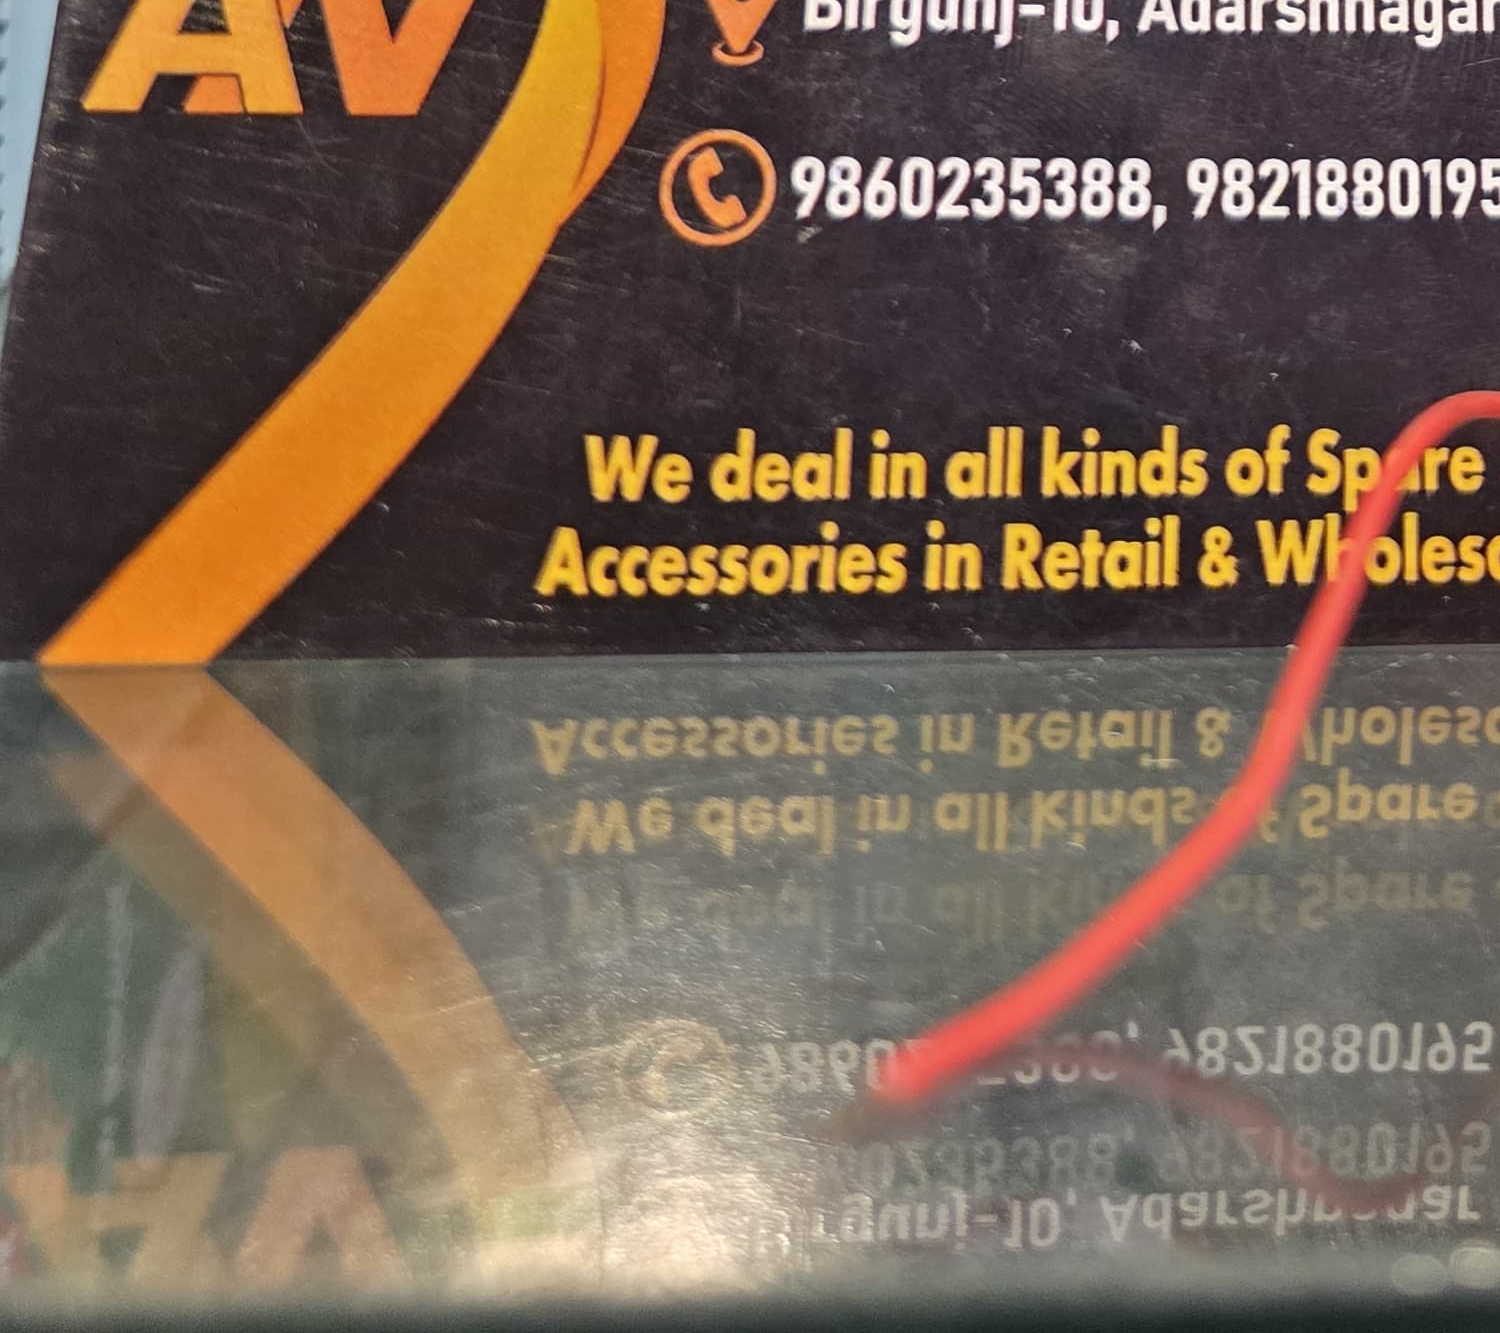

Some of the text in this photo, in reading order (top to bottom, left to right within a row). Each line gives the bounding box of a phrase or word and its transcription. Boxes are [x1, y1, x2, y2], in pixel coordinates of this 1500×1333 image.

[791, 155, 1169, 233] 9860235388,
[583, 433, 694, 503] We
[708, 427, 854, 502] deal
[868, 428, 928, 500] in
[944, 425, 1024, 499] all
[1040, 424, 1209, 499] kinds
[1224, 423, 1292, 498] of
[533, 519, 908, 598] Accessories
[923, 518, 983, 592] in
[1001, 514, 1181, 590] Retail
[1198, 525, 1240, 588] &
